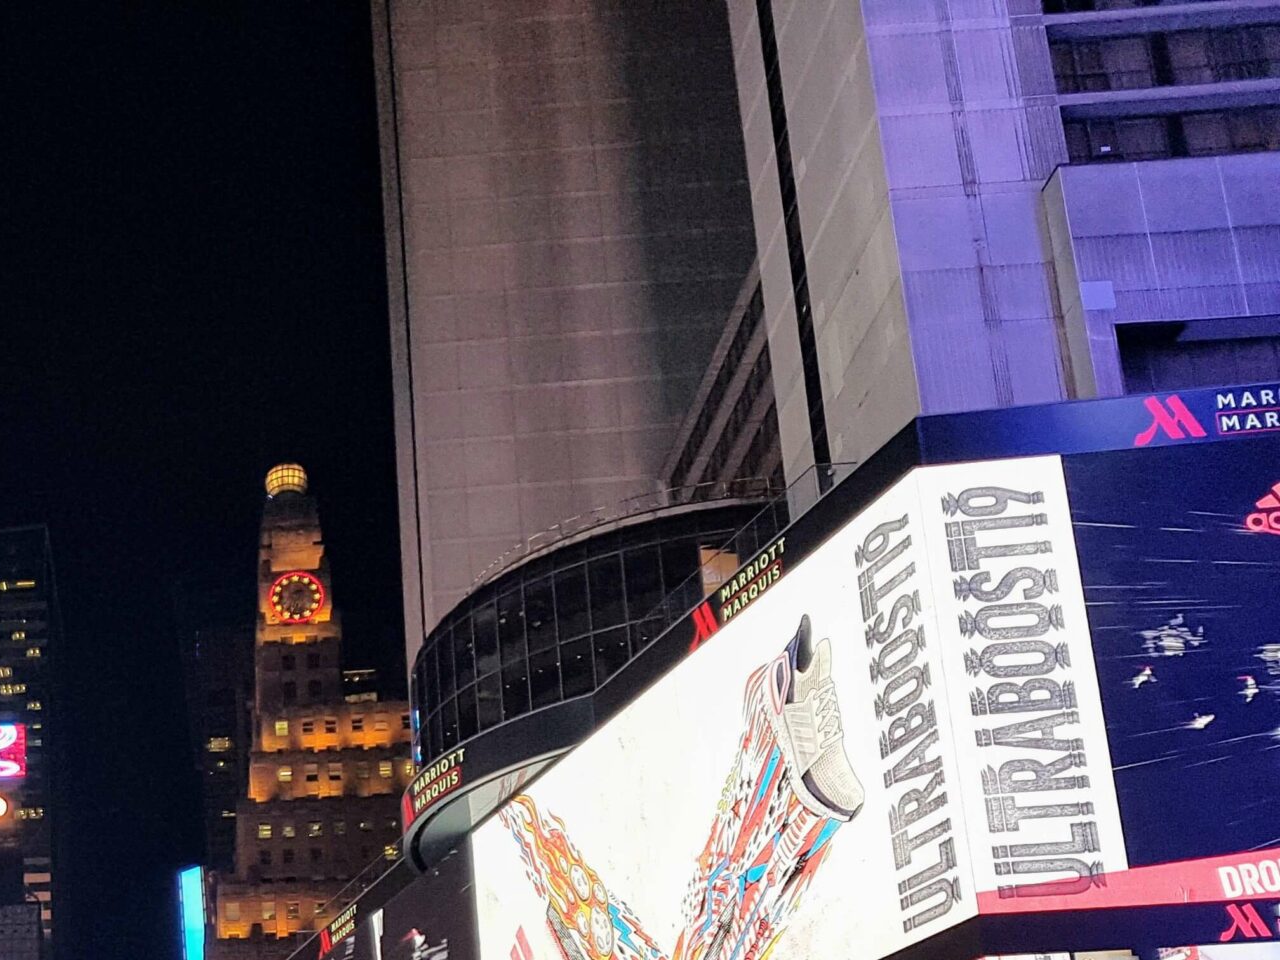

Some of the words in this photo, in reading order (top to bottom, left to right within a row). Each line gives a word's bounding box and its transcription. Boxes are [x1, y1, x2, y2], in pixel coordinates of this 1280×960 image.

[1217, 389, 1280, 410] MAR
[720, 537, 788, 602] MARRIOTT
[722, 563, 782, 622] MARQUIS
[413, 748, 466, 796] MARRIOTT
[415, 770, 460, 812] MARQUIS
[1217, 858, 1280, 898] DRO
[331, 904, 357, 932] MARRIOTT
[331, 920, 356, 945] MARQUIS
